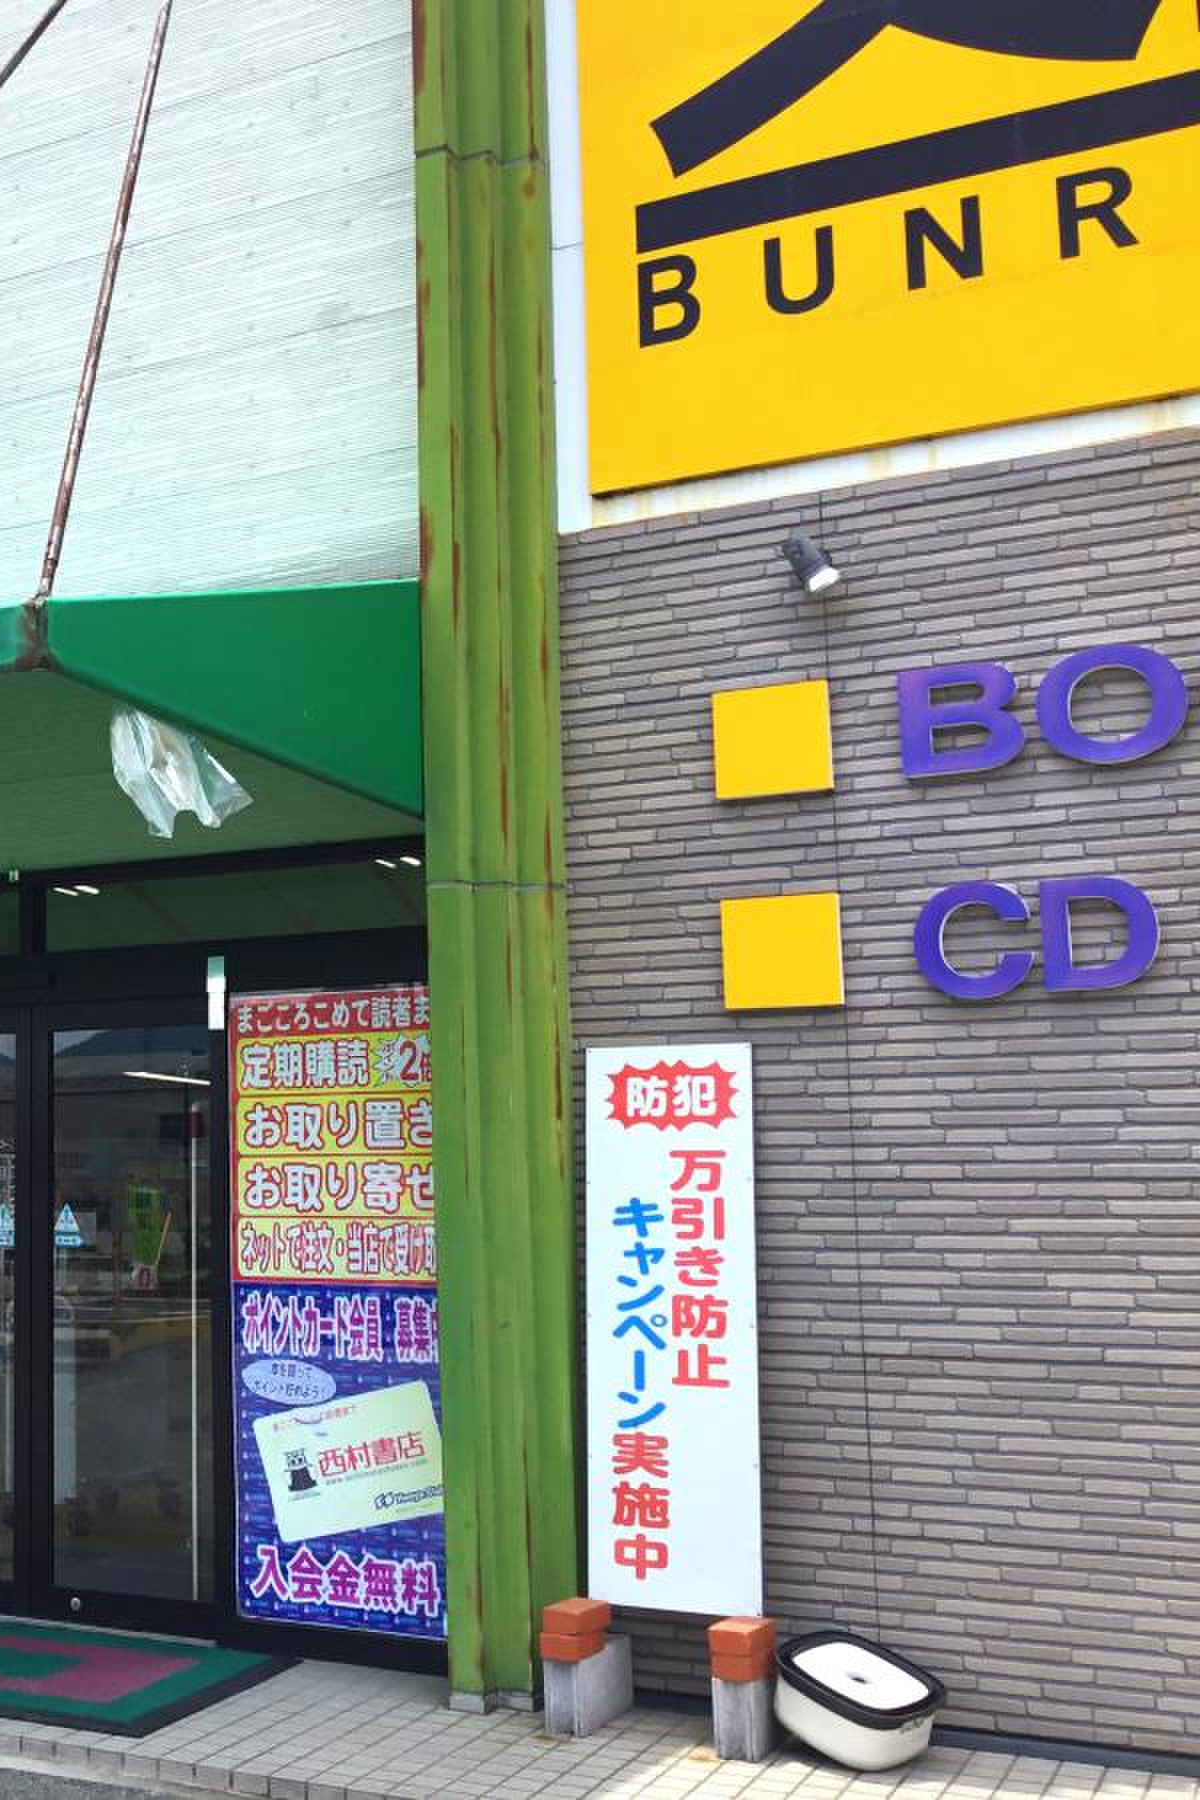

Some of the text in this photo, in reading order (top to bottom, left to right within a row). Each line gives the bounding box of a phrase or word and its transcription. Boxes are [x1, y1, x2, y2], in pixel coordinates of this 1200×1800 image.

[636, 166, 1139, 348] BUNR
[896, 644, 1190, 779] BO
[913, 876, 1161, 999] CD
[241, 1039, 370, 1089] 定期購読
[626, 1076, 718, 1118] 防犯
[244, 1098, 432, 1151] お取り置き
[244, 1161, 432, 1214] お取り寄せ
[669, 1150, 730, 1389] 万引き防止
[242, 1291, 383, 1361] ポイントカード会員
[612, 1197, 671, 1580] キャンペーン実施中
[319, 1432, 425, 1477] 西村書店
[250, 1546, 440, 1617] 入会金無料
